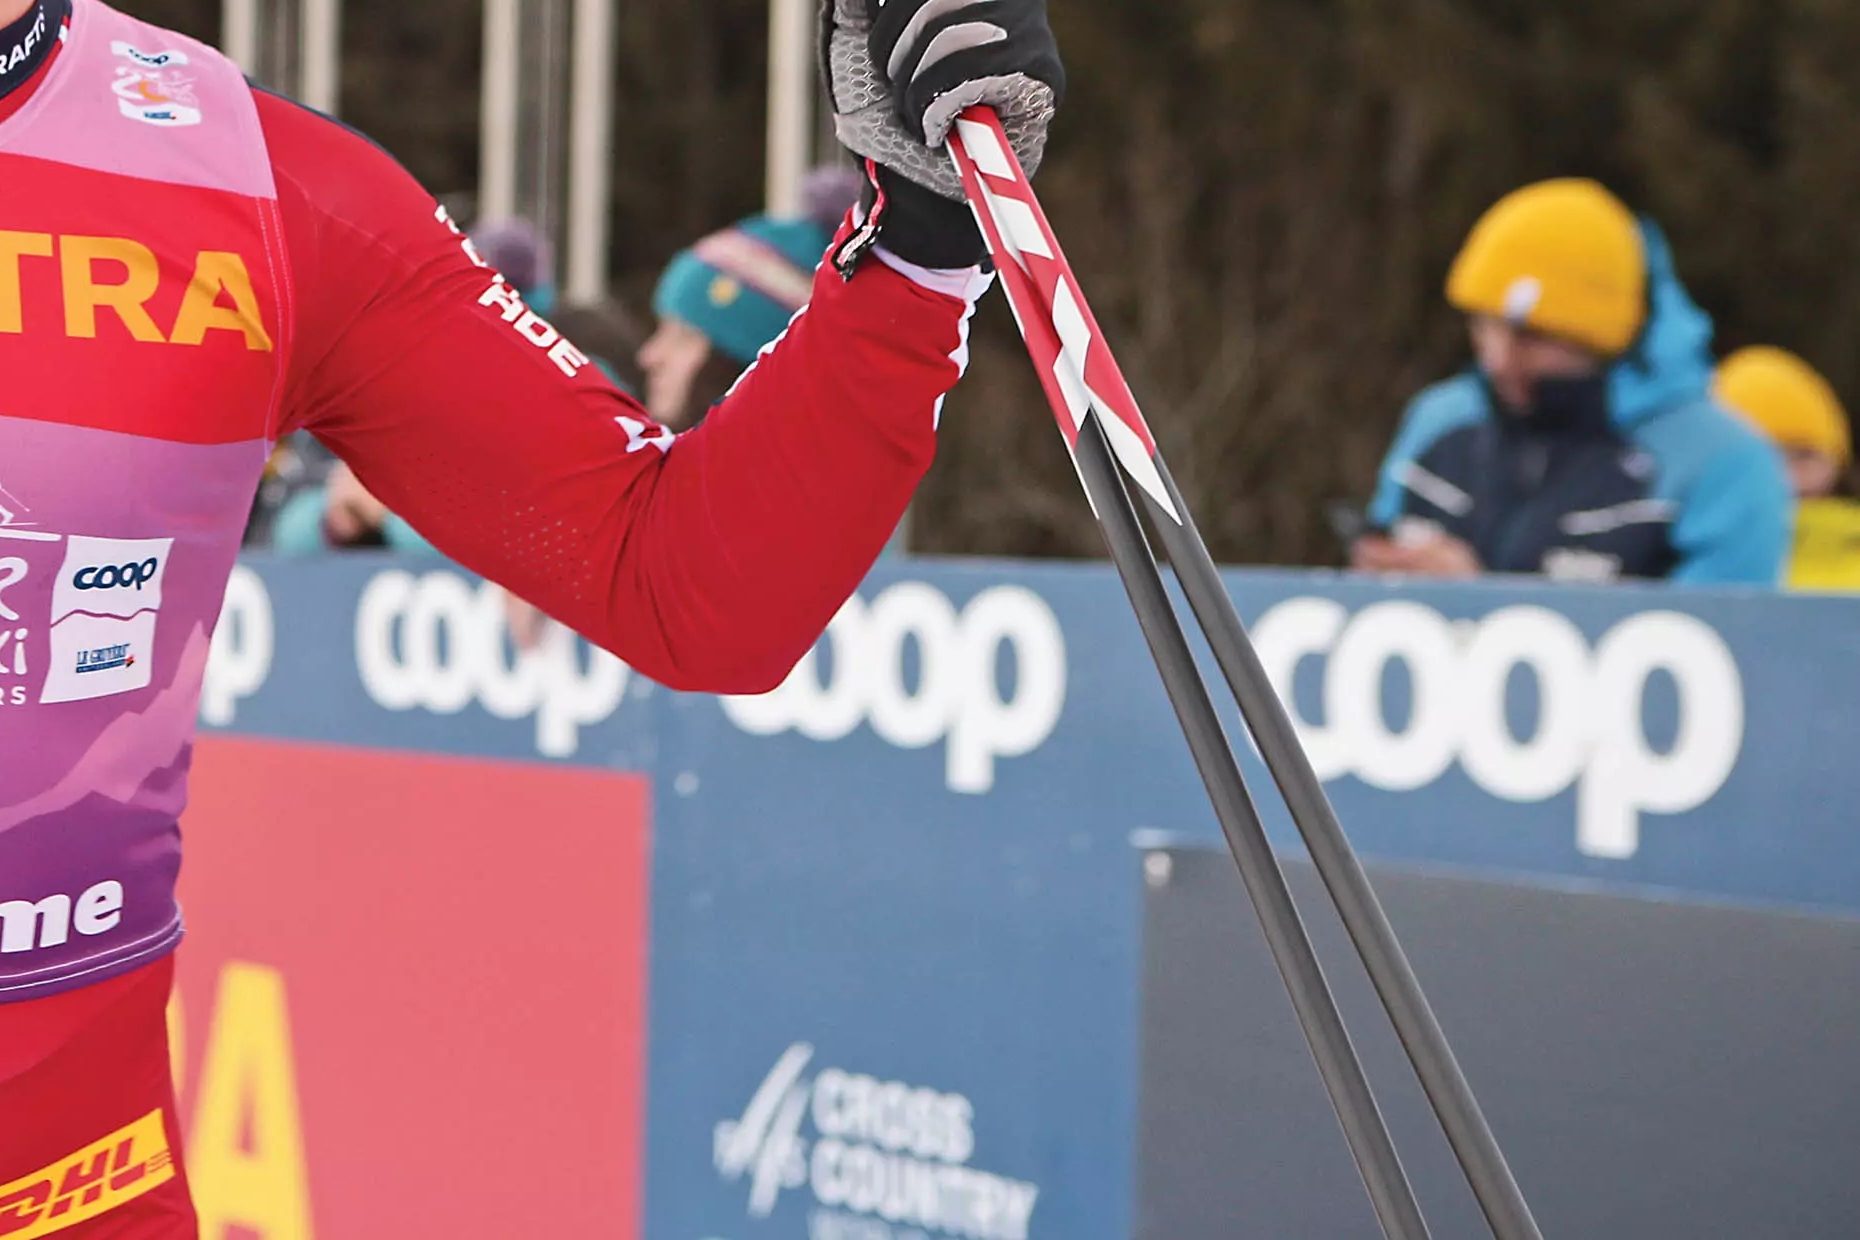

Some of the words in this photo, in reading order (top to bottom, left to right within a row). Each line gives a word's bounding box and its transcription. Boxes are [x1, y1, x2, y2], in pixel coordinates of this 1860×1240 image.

[73, 557, 157, 591] coop
[717, 580, 1067, 794] oop
[1241, 596, 1743, 858] coop
